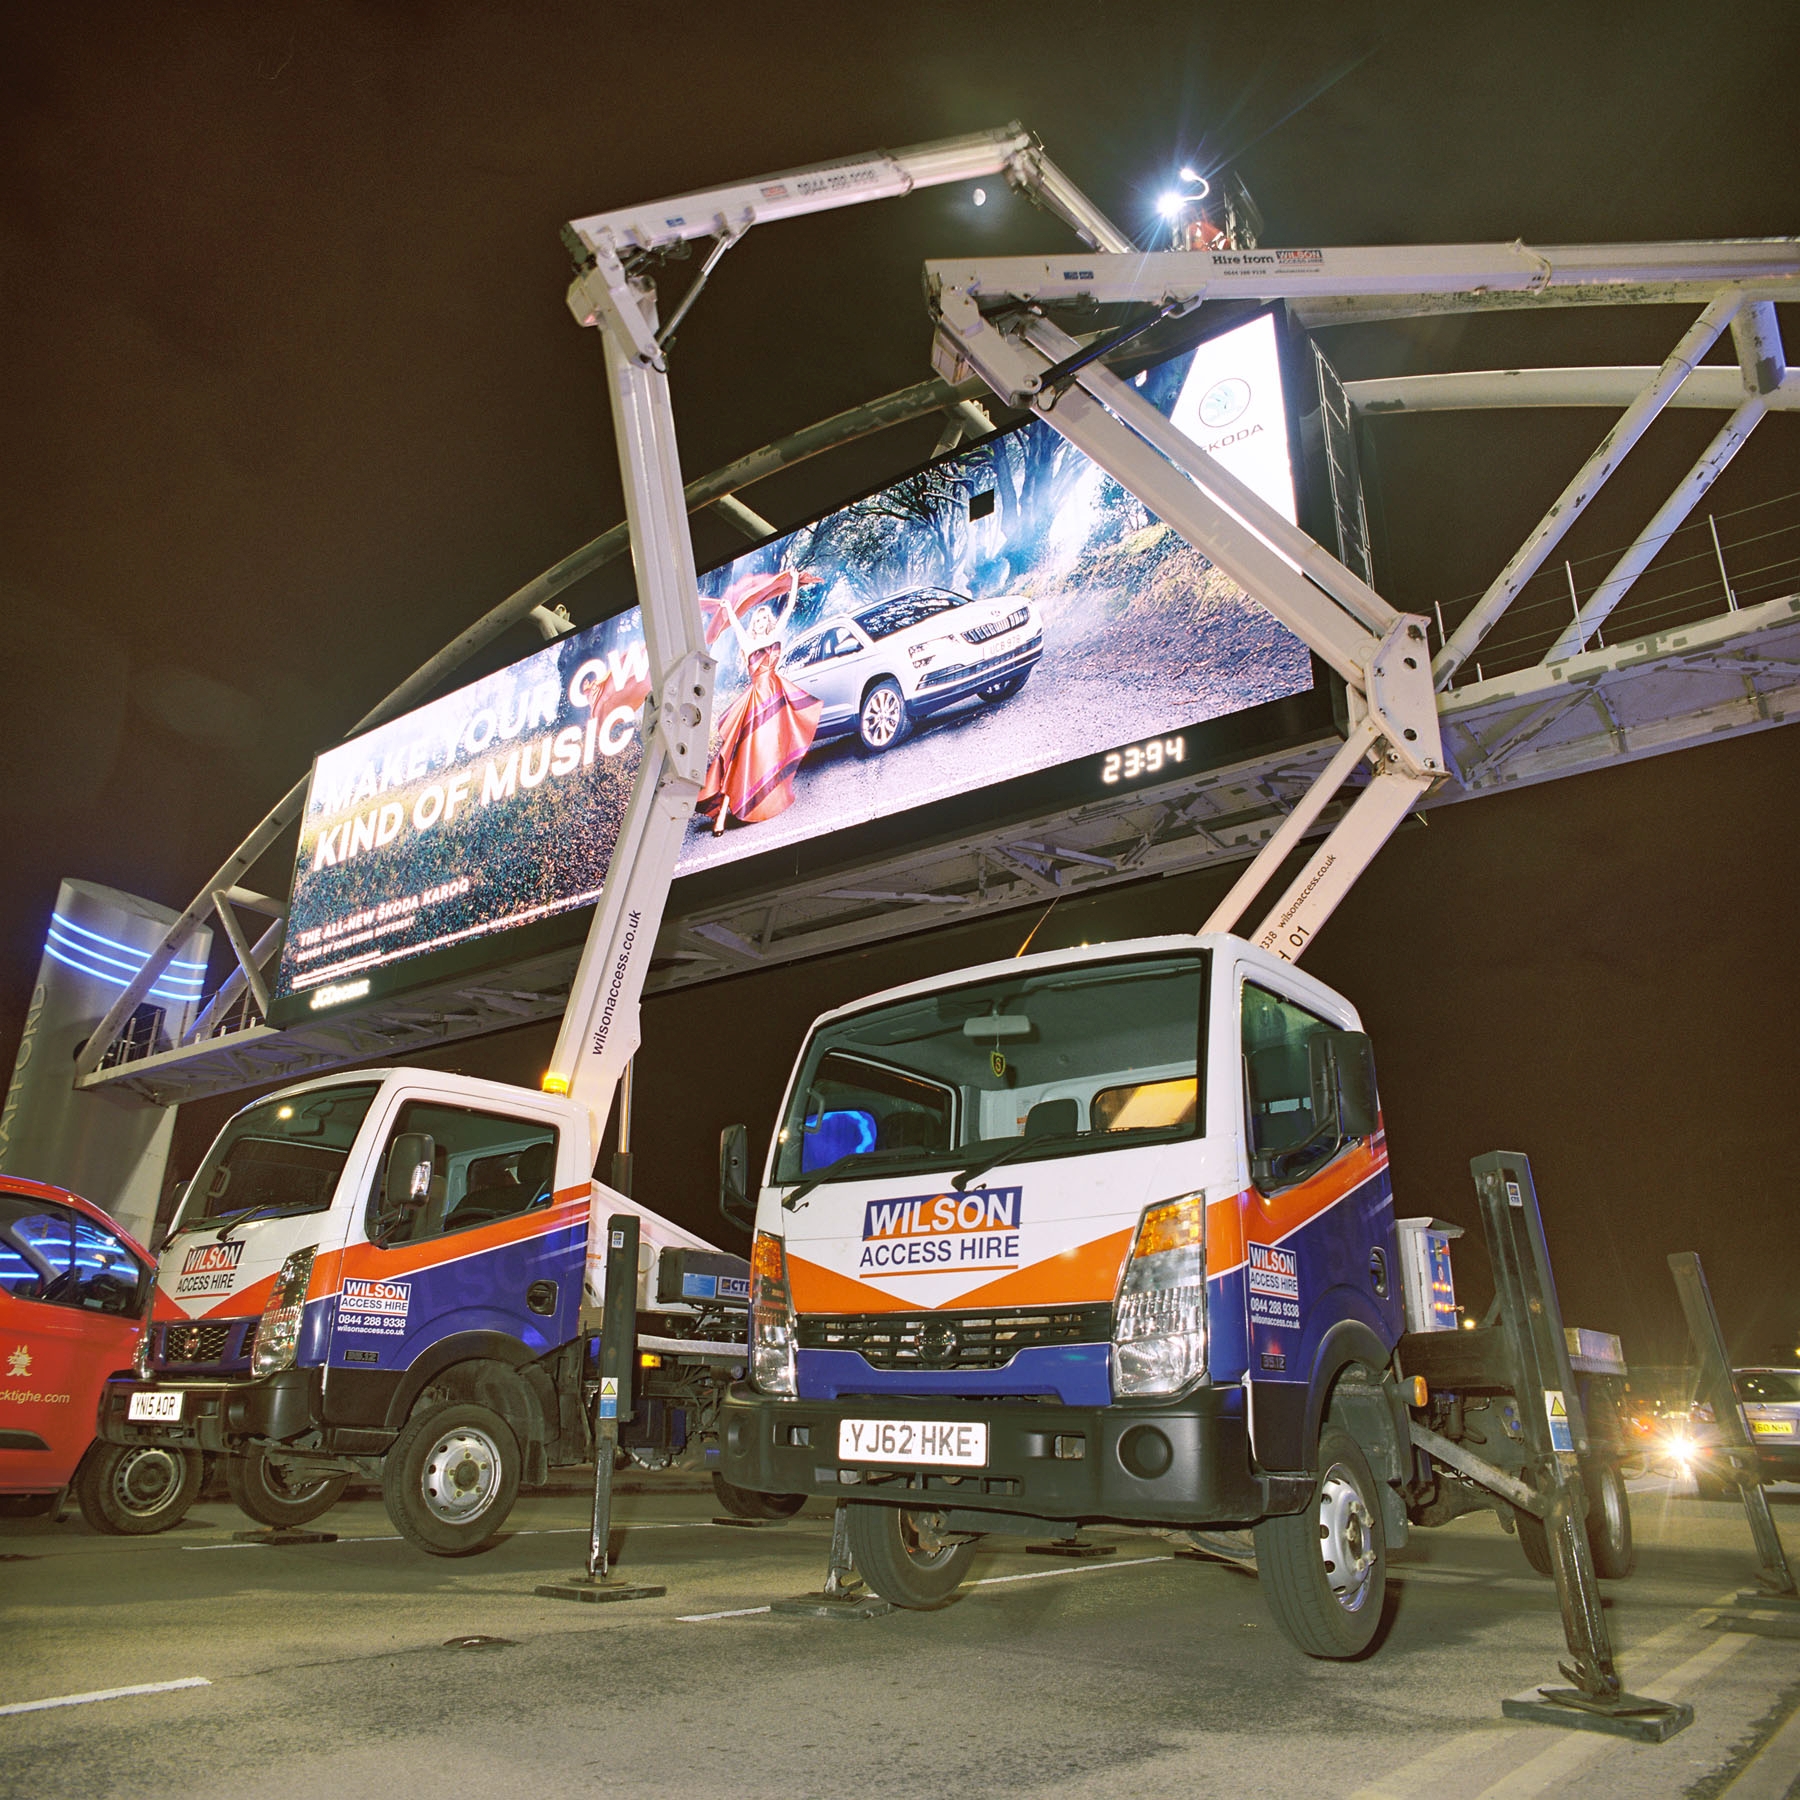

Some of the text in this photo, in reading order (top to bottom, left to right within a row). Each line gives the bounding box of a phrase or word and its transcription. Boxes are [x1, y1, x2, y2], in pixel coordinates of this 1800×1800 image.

[1212, 254, 1274, 265] Hire from
[1279, 250, 1321, 259] WILSON
[322, 640, 650, 815] MAKE YOUR OW
[312, 704, 636, 872] KIND OF MUSIC
[1277, 854, 1336, 929] wilsonaccess.co.uk
[300, 929, 322, 947] THE
[322, 908, 376, 939] ALL-NEW
[420, 877, 470, 906] KAROQ
[374, 916, 416, 937] DIFFERENT
[1289, 925, 1310, 947] 01
[592, 909, 642, 1056] wilsonaccess.co.uk
[870, 1192, 1014, 1236] WILSON
[185, 1244, 242, 1272] WILSON
[859, 1235, 1019, 1268] ACCESS HIRE
[1250, 1246, 1294, 1275] WILSON
[176, 1273, 236, 1292] ACCESS HIRE
[346, 1281, 407, 1300] WILSON
[1250, 1272, 1298, 1292] ACCESS HIRE
[341, 1297, 408, 1311] ACCESS HIRE
[1250, 1297, 1299, 1317] 0844 288 9338
[337, 1324, 405, 1336] wilsonaccess.co.uk
[338, 1314, 406, 1328] 0844 288 9338
[1250, 1313, 1300, 1329] wilsonaccess.co.uk
[156, 1396, 176, 1416] AOR
[851, 1424, 972, 1457] YJ62 HKE
